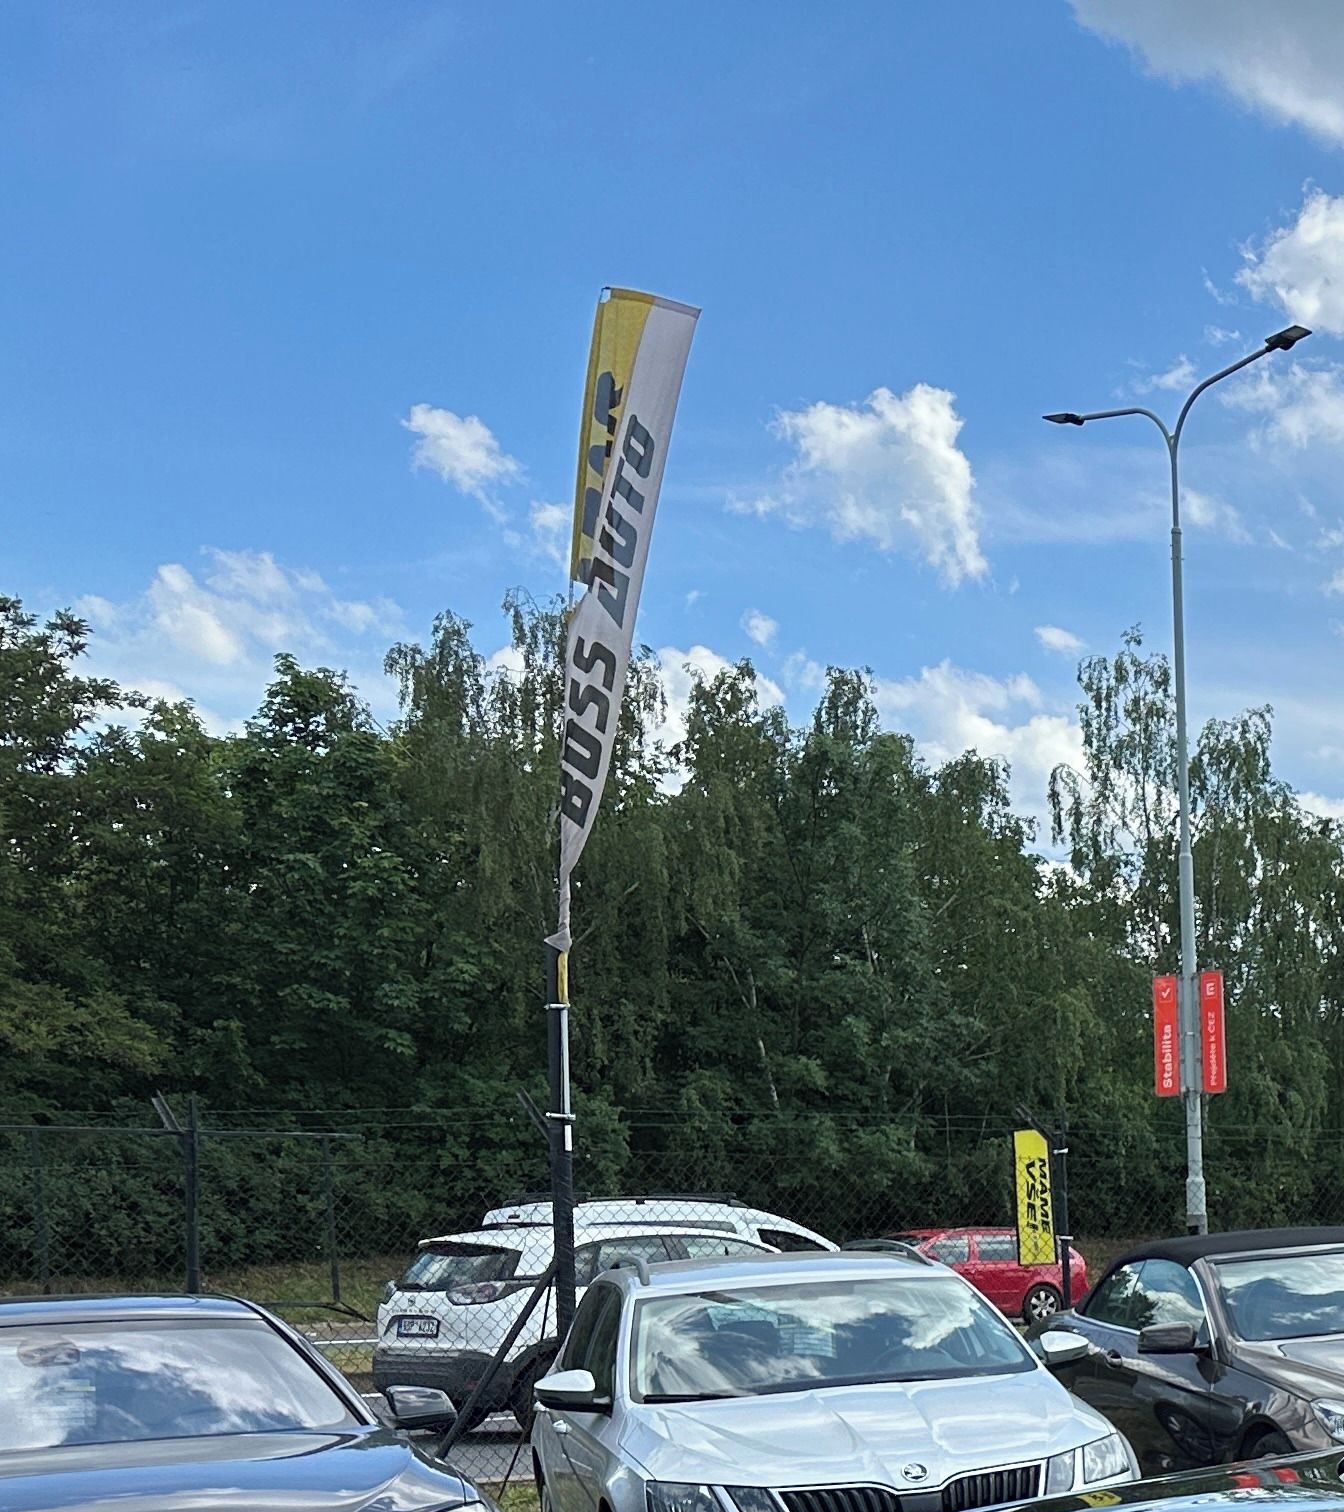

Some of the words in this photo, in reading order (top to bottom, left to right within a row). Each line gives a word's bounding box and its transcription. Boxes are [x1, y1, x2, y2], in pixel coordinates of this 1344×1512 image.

[588, 414, 655, 630] AUTO
[561, 636, 617, 829] BOSS
[1161, 1024, 1173, 1089] Stabilita
